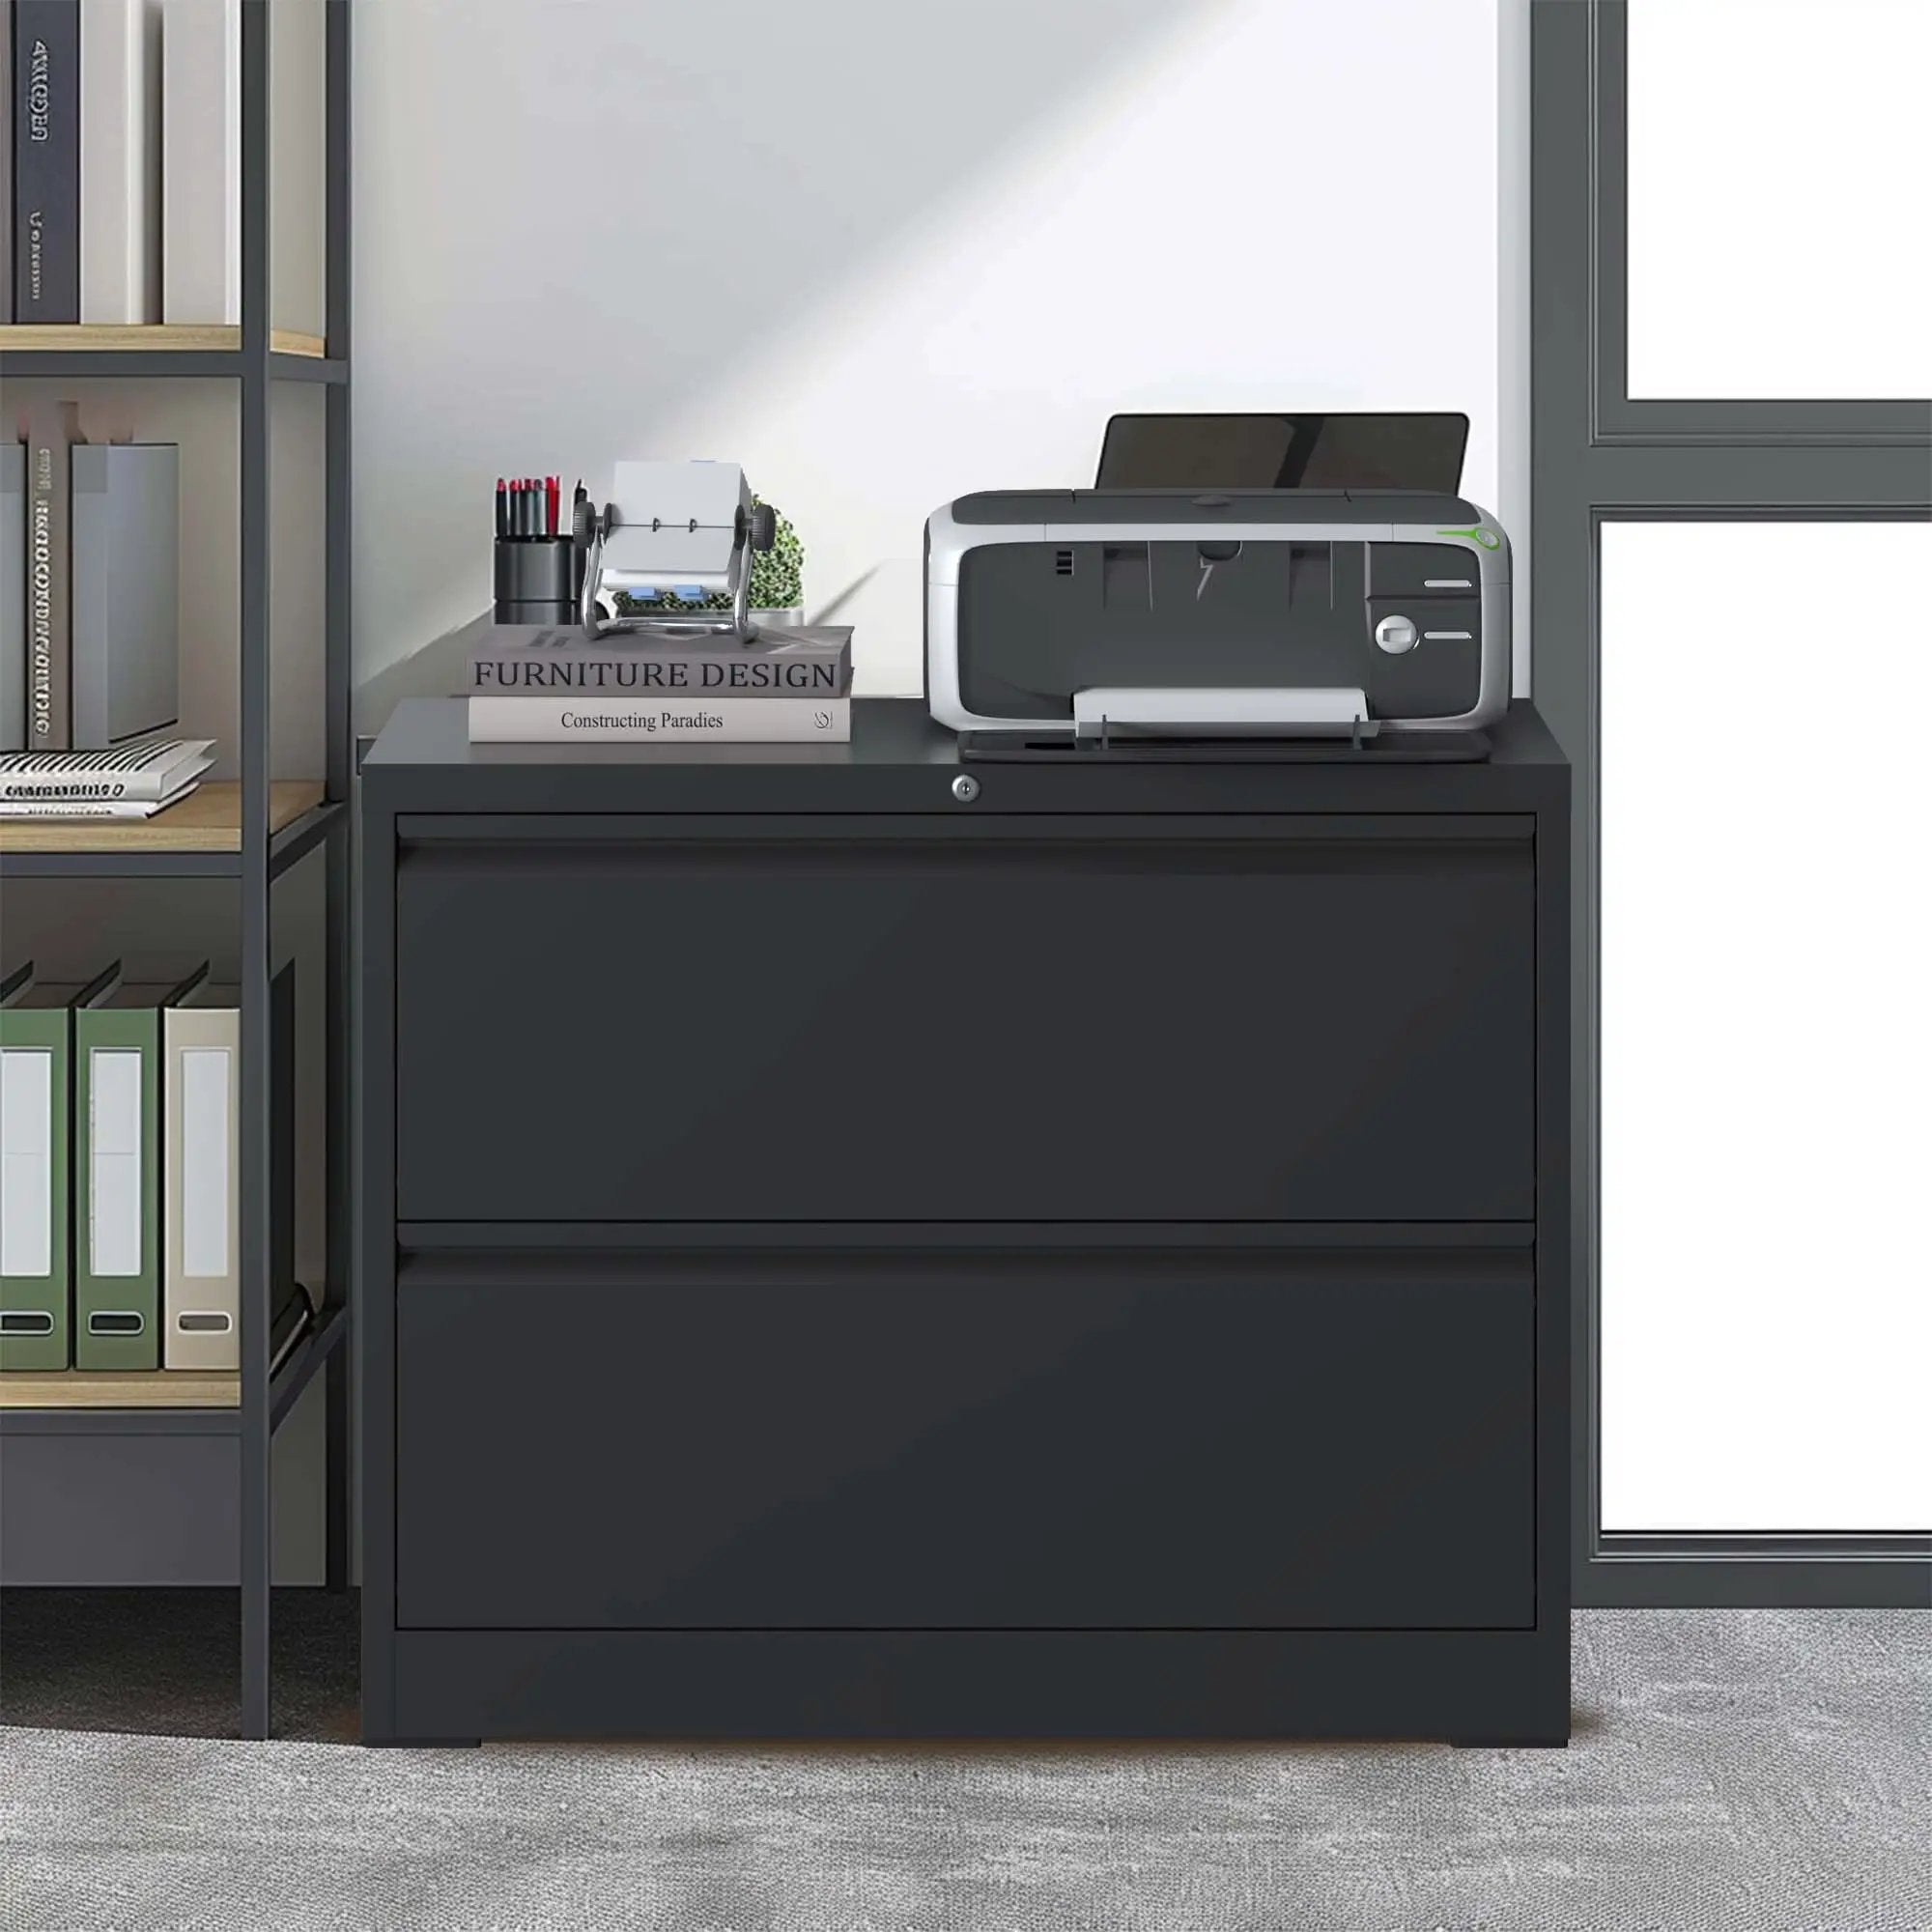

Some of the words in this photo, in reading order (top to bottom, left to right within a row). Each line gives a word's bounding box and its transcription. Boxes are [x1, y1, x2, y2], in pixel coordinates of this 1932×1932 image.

[474, 662, 688, 688] FURNITURE
[701, 663, 836, 689] DESIGN
[560, 712, 657, 732] Constructing
[661, 712, 724, 728] Paradies
